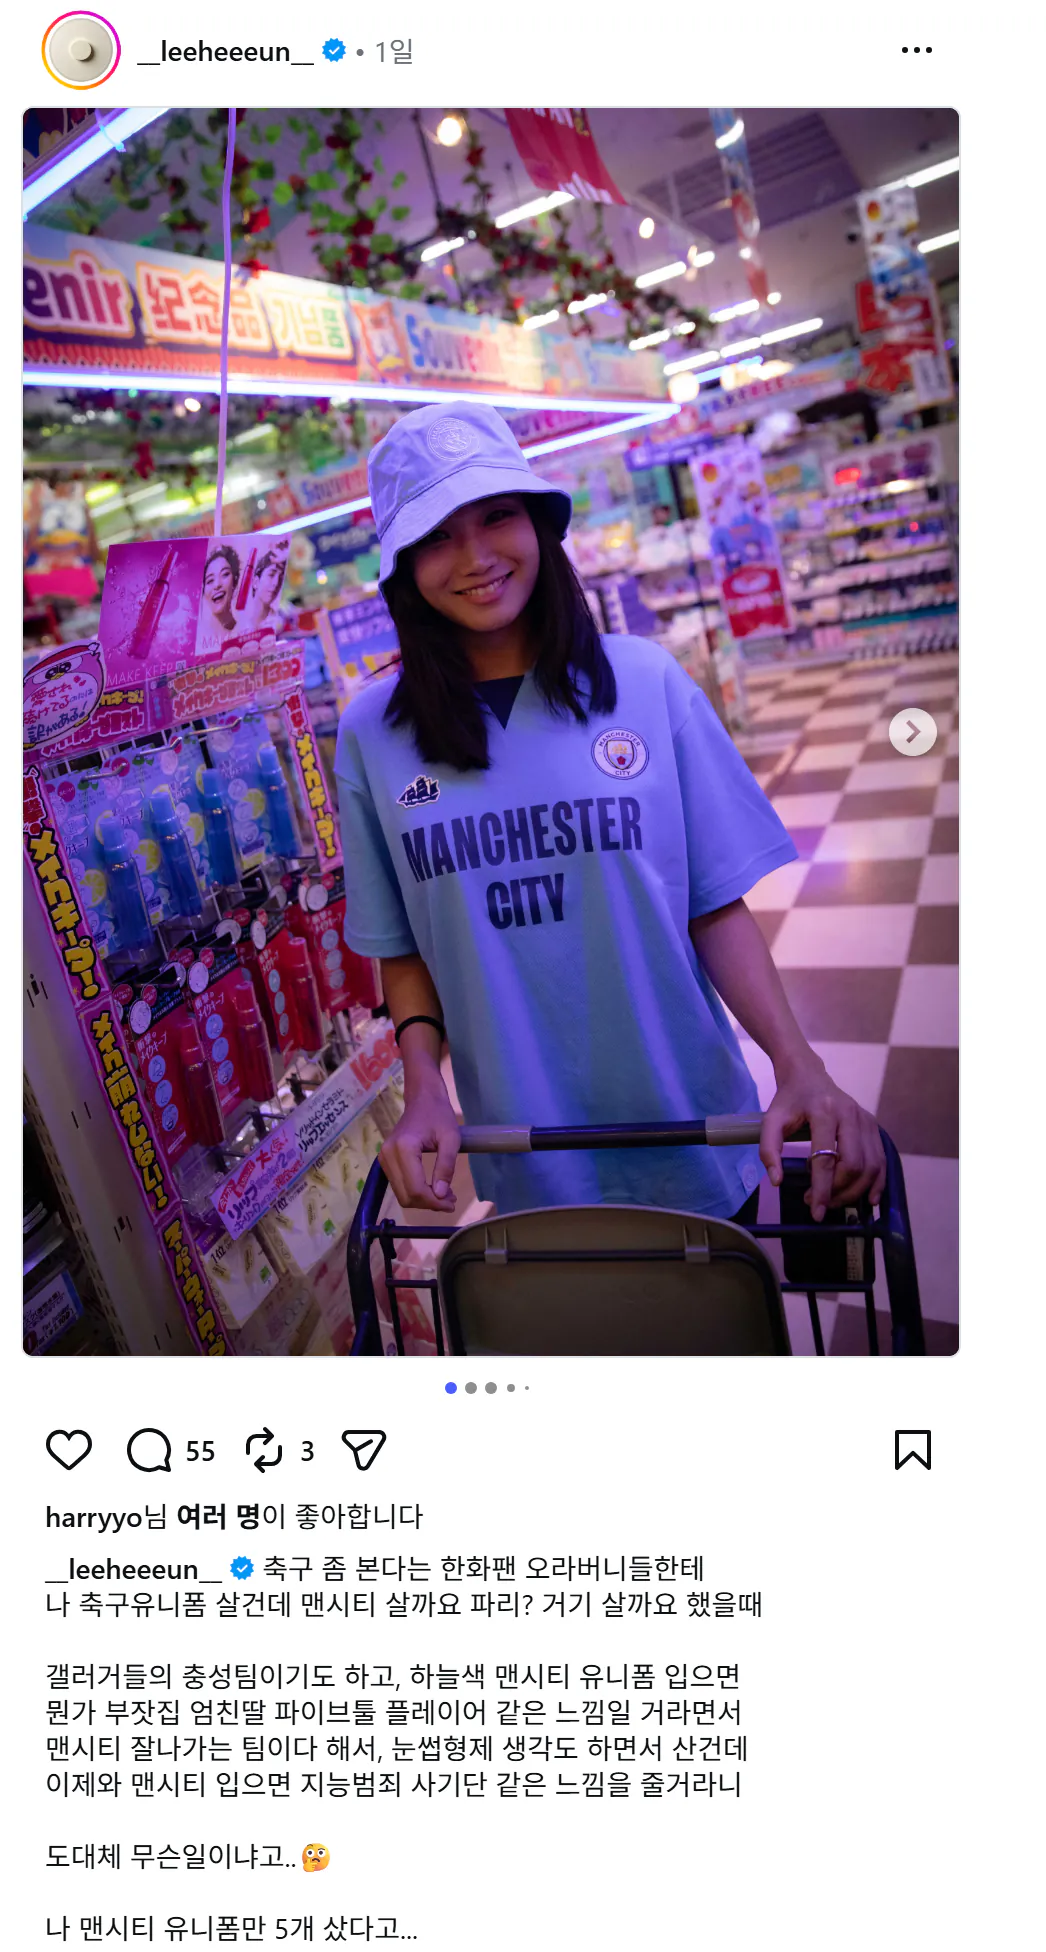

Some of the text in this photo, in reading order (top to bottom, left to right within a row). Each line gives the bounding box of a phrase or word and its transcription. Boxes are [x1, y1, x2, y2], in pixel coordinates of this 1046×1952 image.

[598, 731, 641, 747] MANCHESTER
[401, 797, 643, 884] MANCHESTER
[486, 873, 565, 931] CITY
[298, 1100, 350, 1152] リップエッセンス
